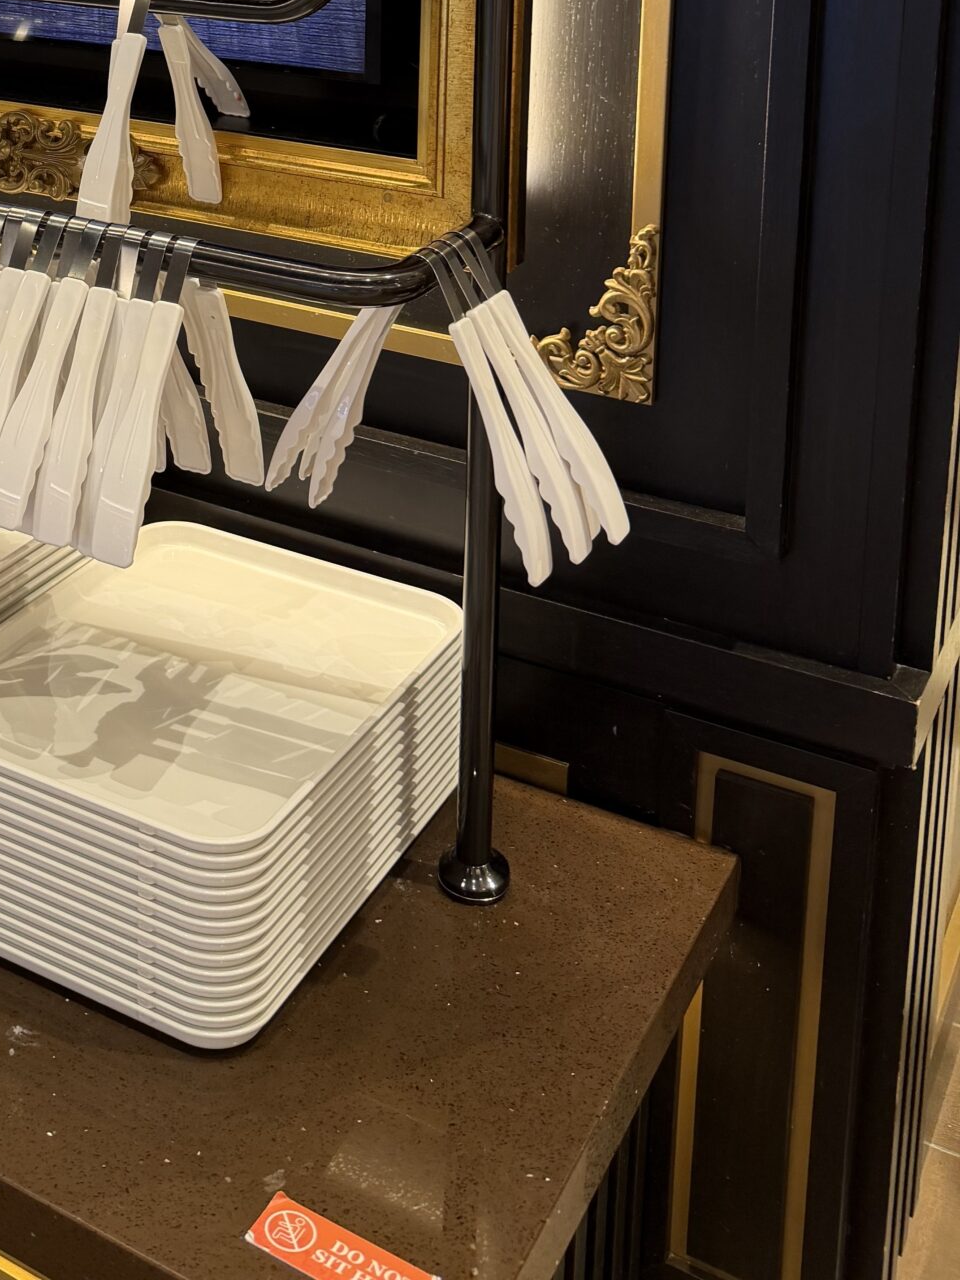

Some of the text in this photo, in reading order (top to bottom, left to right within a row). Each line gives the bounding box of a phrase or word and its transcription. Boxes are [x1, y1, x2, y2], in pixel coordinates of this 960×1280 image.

[311, 1248, 352, 1275] SIT
[331, 1240, 365, 1265] DO
[367, 1259, 411, 1280] NO
